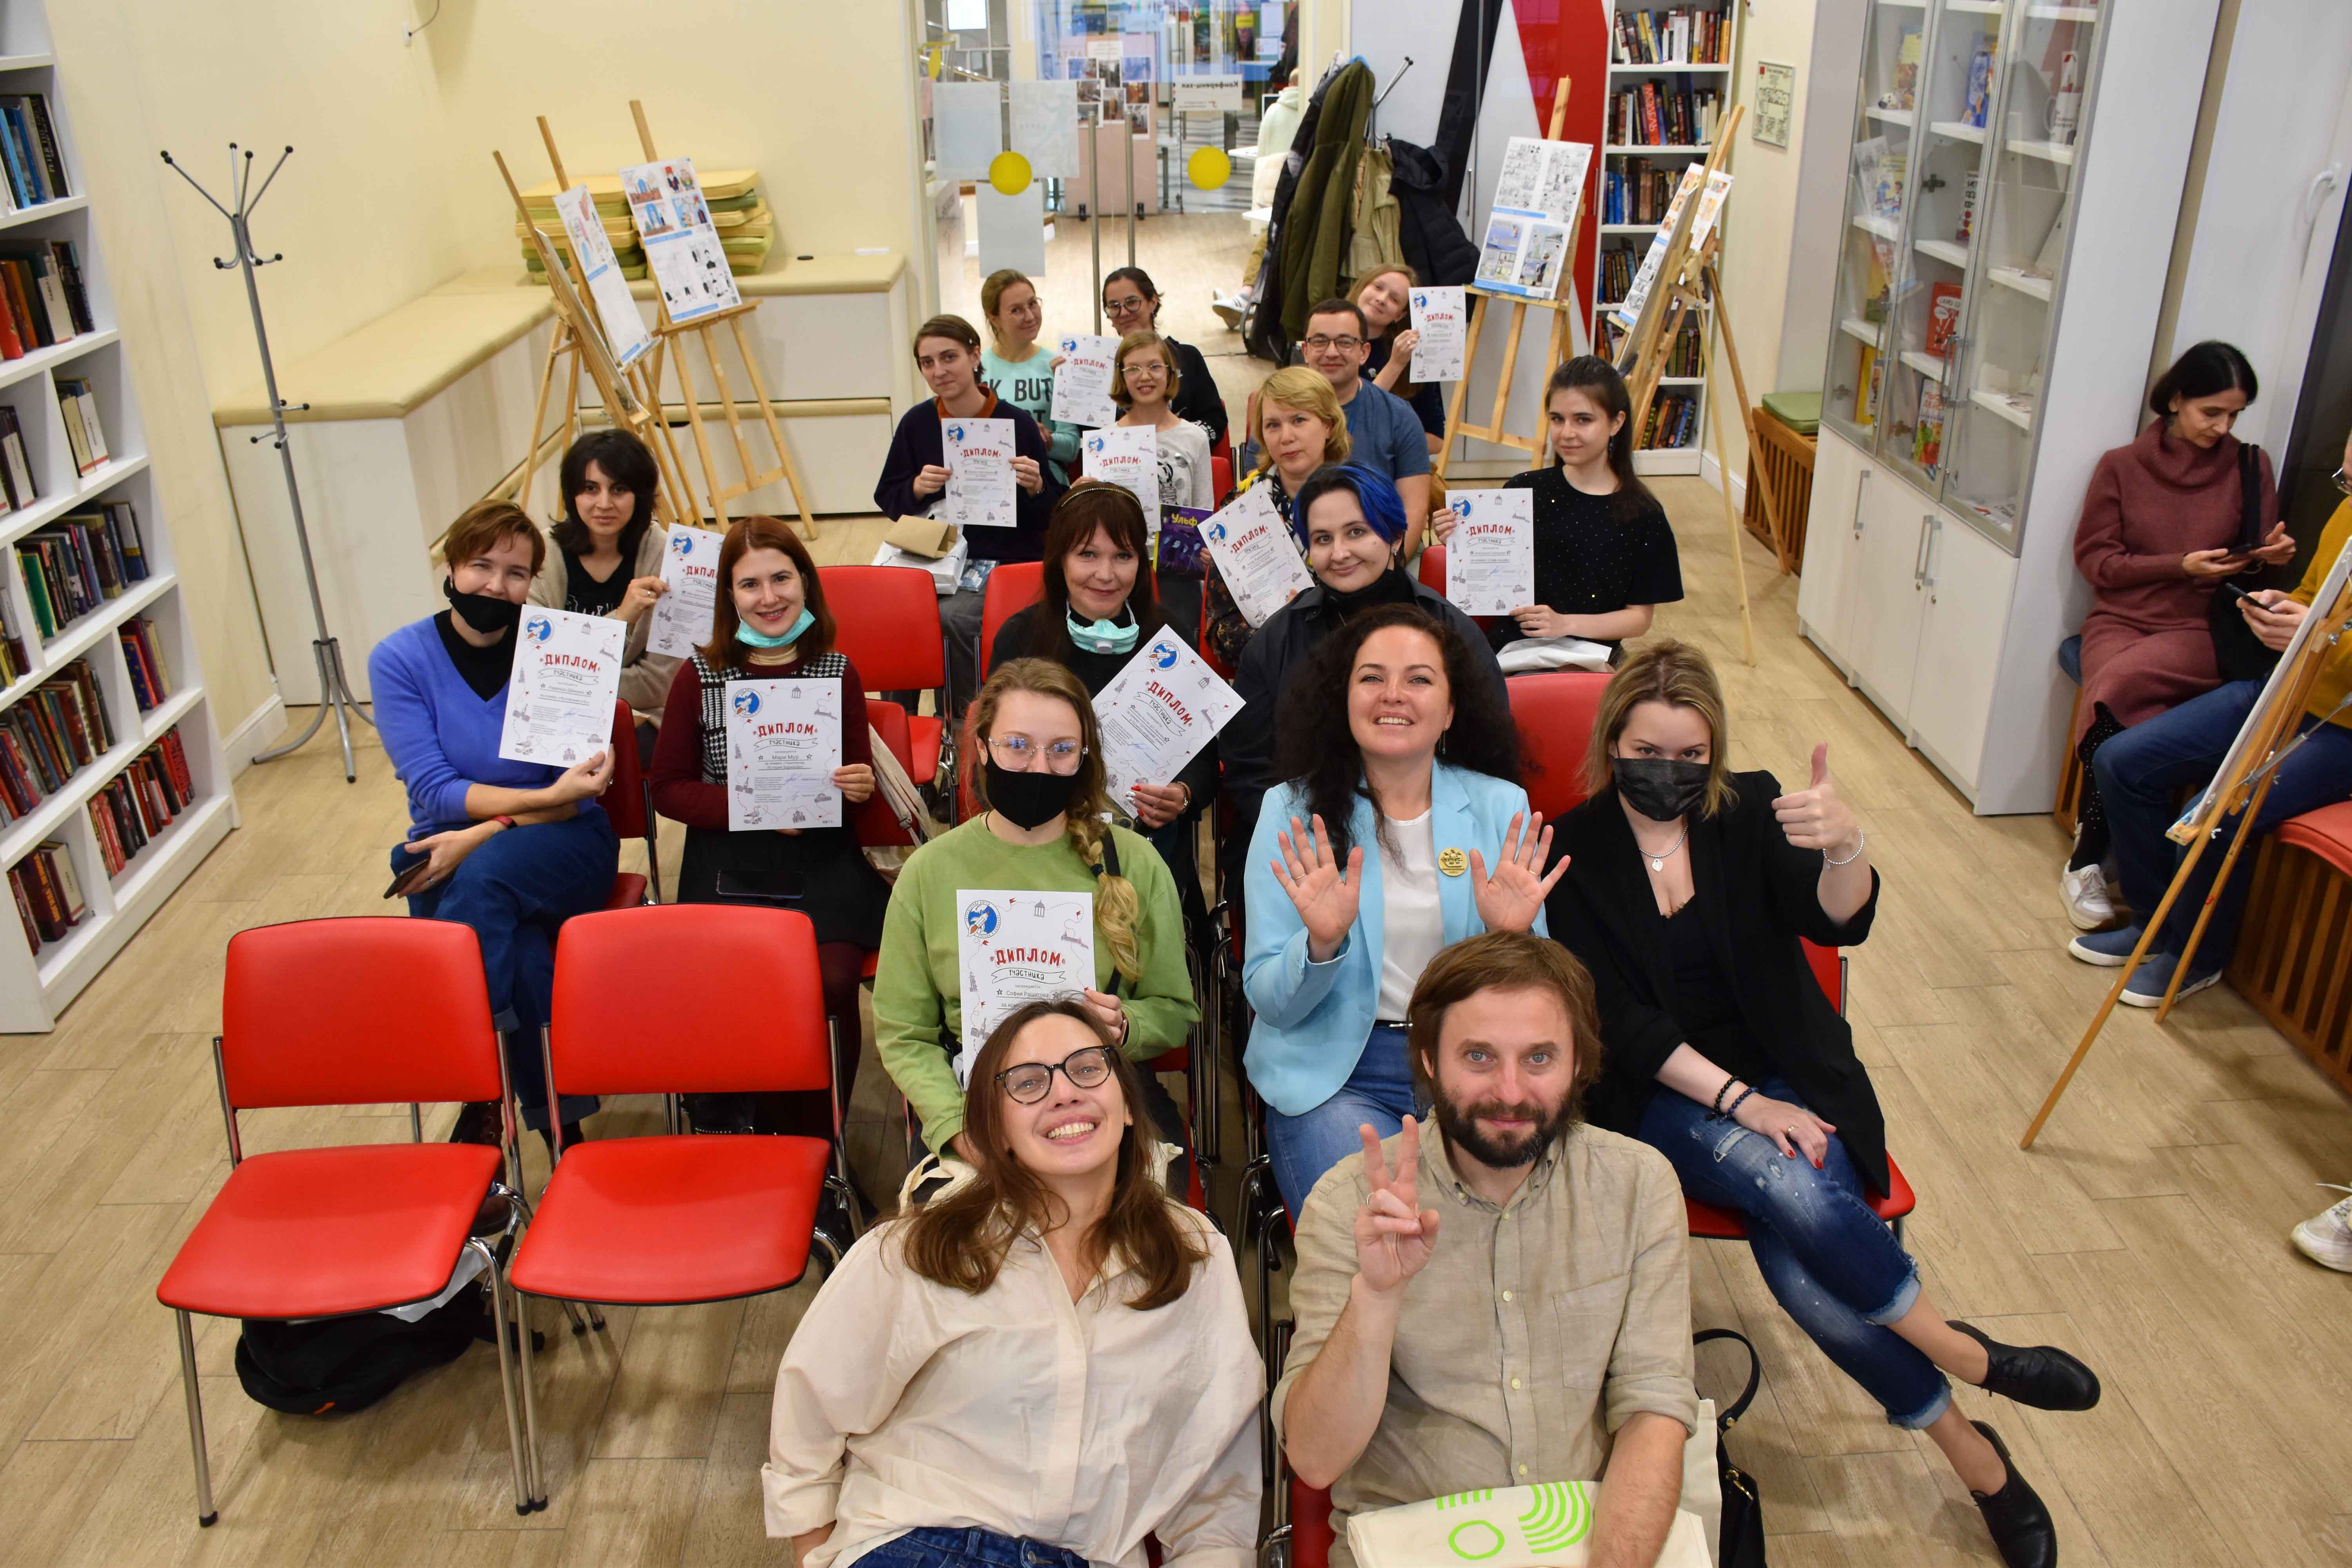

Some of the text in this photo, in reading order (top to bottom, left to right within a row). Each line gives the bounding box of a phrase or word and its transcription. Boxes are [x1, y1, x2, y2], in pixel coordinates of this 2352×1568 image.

[1426, 313, 1454, 322] ДИПЛОМ
[1073, 359, 1105, 369] ДИПЛОМ
[1014, 377, 1051, 402] BUT
[963, 448, 999, 458] ДИПЛОМ
[1102, 456, 1139, 467] ДИПЛОМ
[1171, 513, 1198, 527] Ульф
[1470, 524, 1512, 536] ДИПЛОМ
[1232, 525, 1267, 553] ДИПЛОМ
[686, 566, 717, 578] ДИПЛ
[545, 654, 598, 672] ДИПЛОМ
[1148, 681, 1192, 725] ДИПЛОМ
[759, 722, 814, 738] ДИПЛОМ
[996, 948, 1060, 966] ДИПЛОМ
